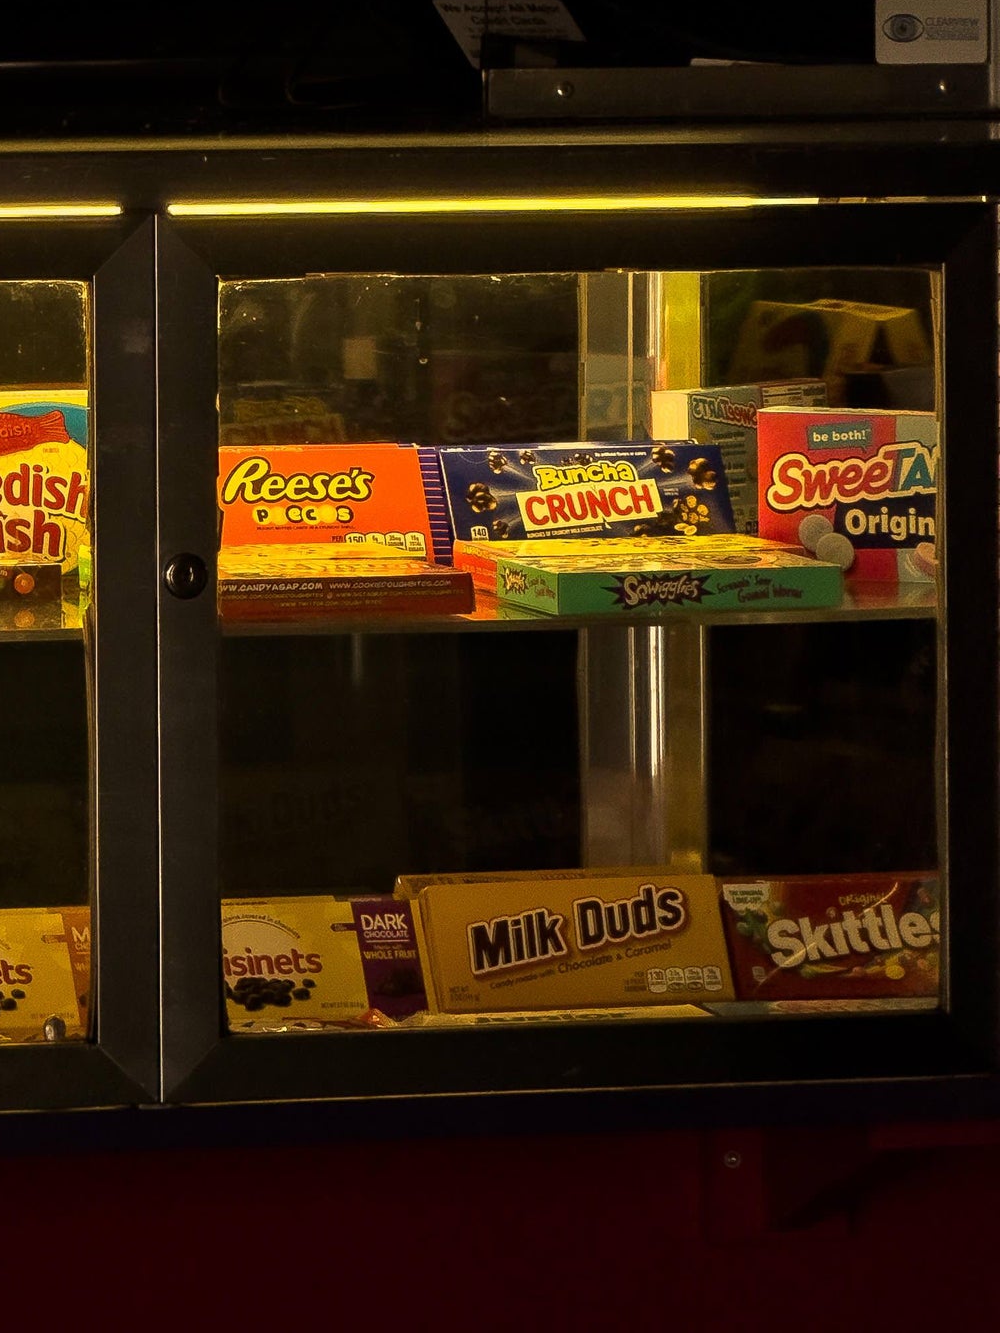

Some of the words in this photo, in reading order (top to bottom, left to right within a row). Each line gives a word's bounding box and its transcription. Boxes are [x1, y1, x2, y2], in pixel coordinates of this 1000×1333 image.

[813, 431, 830, 443] be
[832, 429, 867, 442] both!
[223, 457, 374, 504] Reese's
[536, 462, 636, 487] Buncha
[772, 447, 936, 504] SweeTA
[252, 505, 354, 525] pecs
[524, 484, 655, 526] CRUNCH
[472, 527, 487, 537] 140
[360, 913, 408, 931] DARK
[469, 908, 567, 975] Milk
[574, 885, 686, 949] Duds
[363, 930, 409, 939] CHOCOLATE
[363, 950, 392, 960] WHOLE
[394, 949, 416, 959] FRUIT
[557, 955, 613, 974] Chocolate
[625, 940, 672, 959] Caramel
